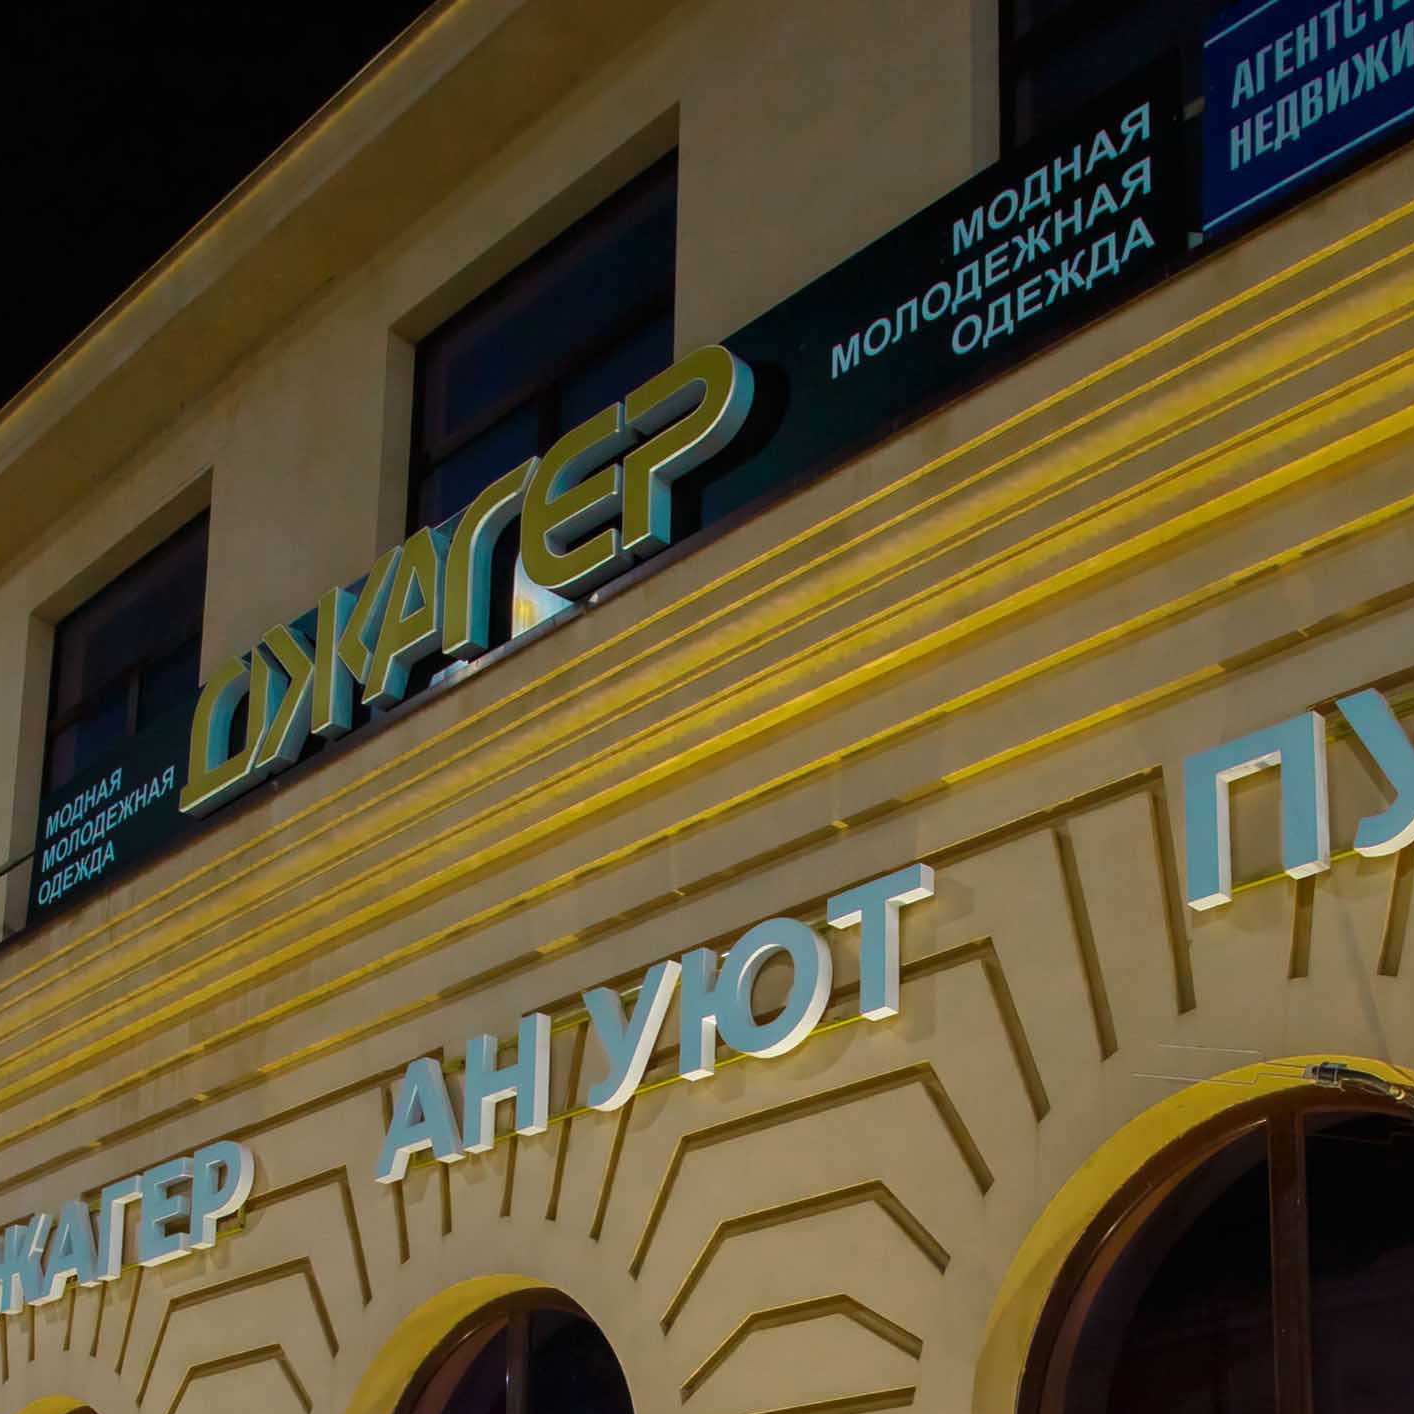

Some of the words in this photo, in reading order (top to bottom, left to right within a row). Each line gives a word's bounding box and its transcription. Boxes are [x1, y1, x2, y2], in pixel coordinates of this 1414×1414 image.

[1231, 0, 1409, 109] АГЕНТС
[952, 101, 1150, 256] МОДНАЯ
[831, 156, 1152, 379] МОЛОДЕЖНАЯ
[951, 216, 1155, 355] ОДЕЖДА
[180, 345, 754, 813] ДЖАГЕР
[38, 840, 115, 905] ОДЕЖДА
[42, 764, 175, 873] МОЛОДЕЖНАЯ
[45, 767, 123, 839] МОДНАЯ
[582, 862, 934, 1112] УЮТ
